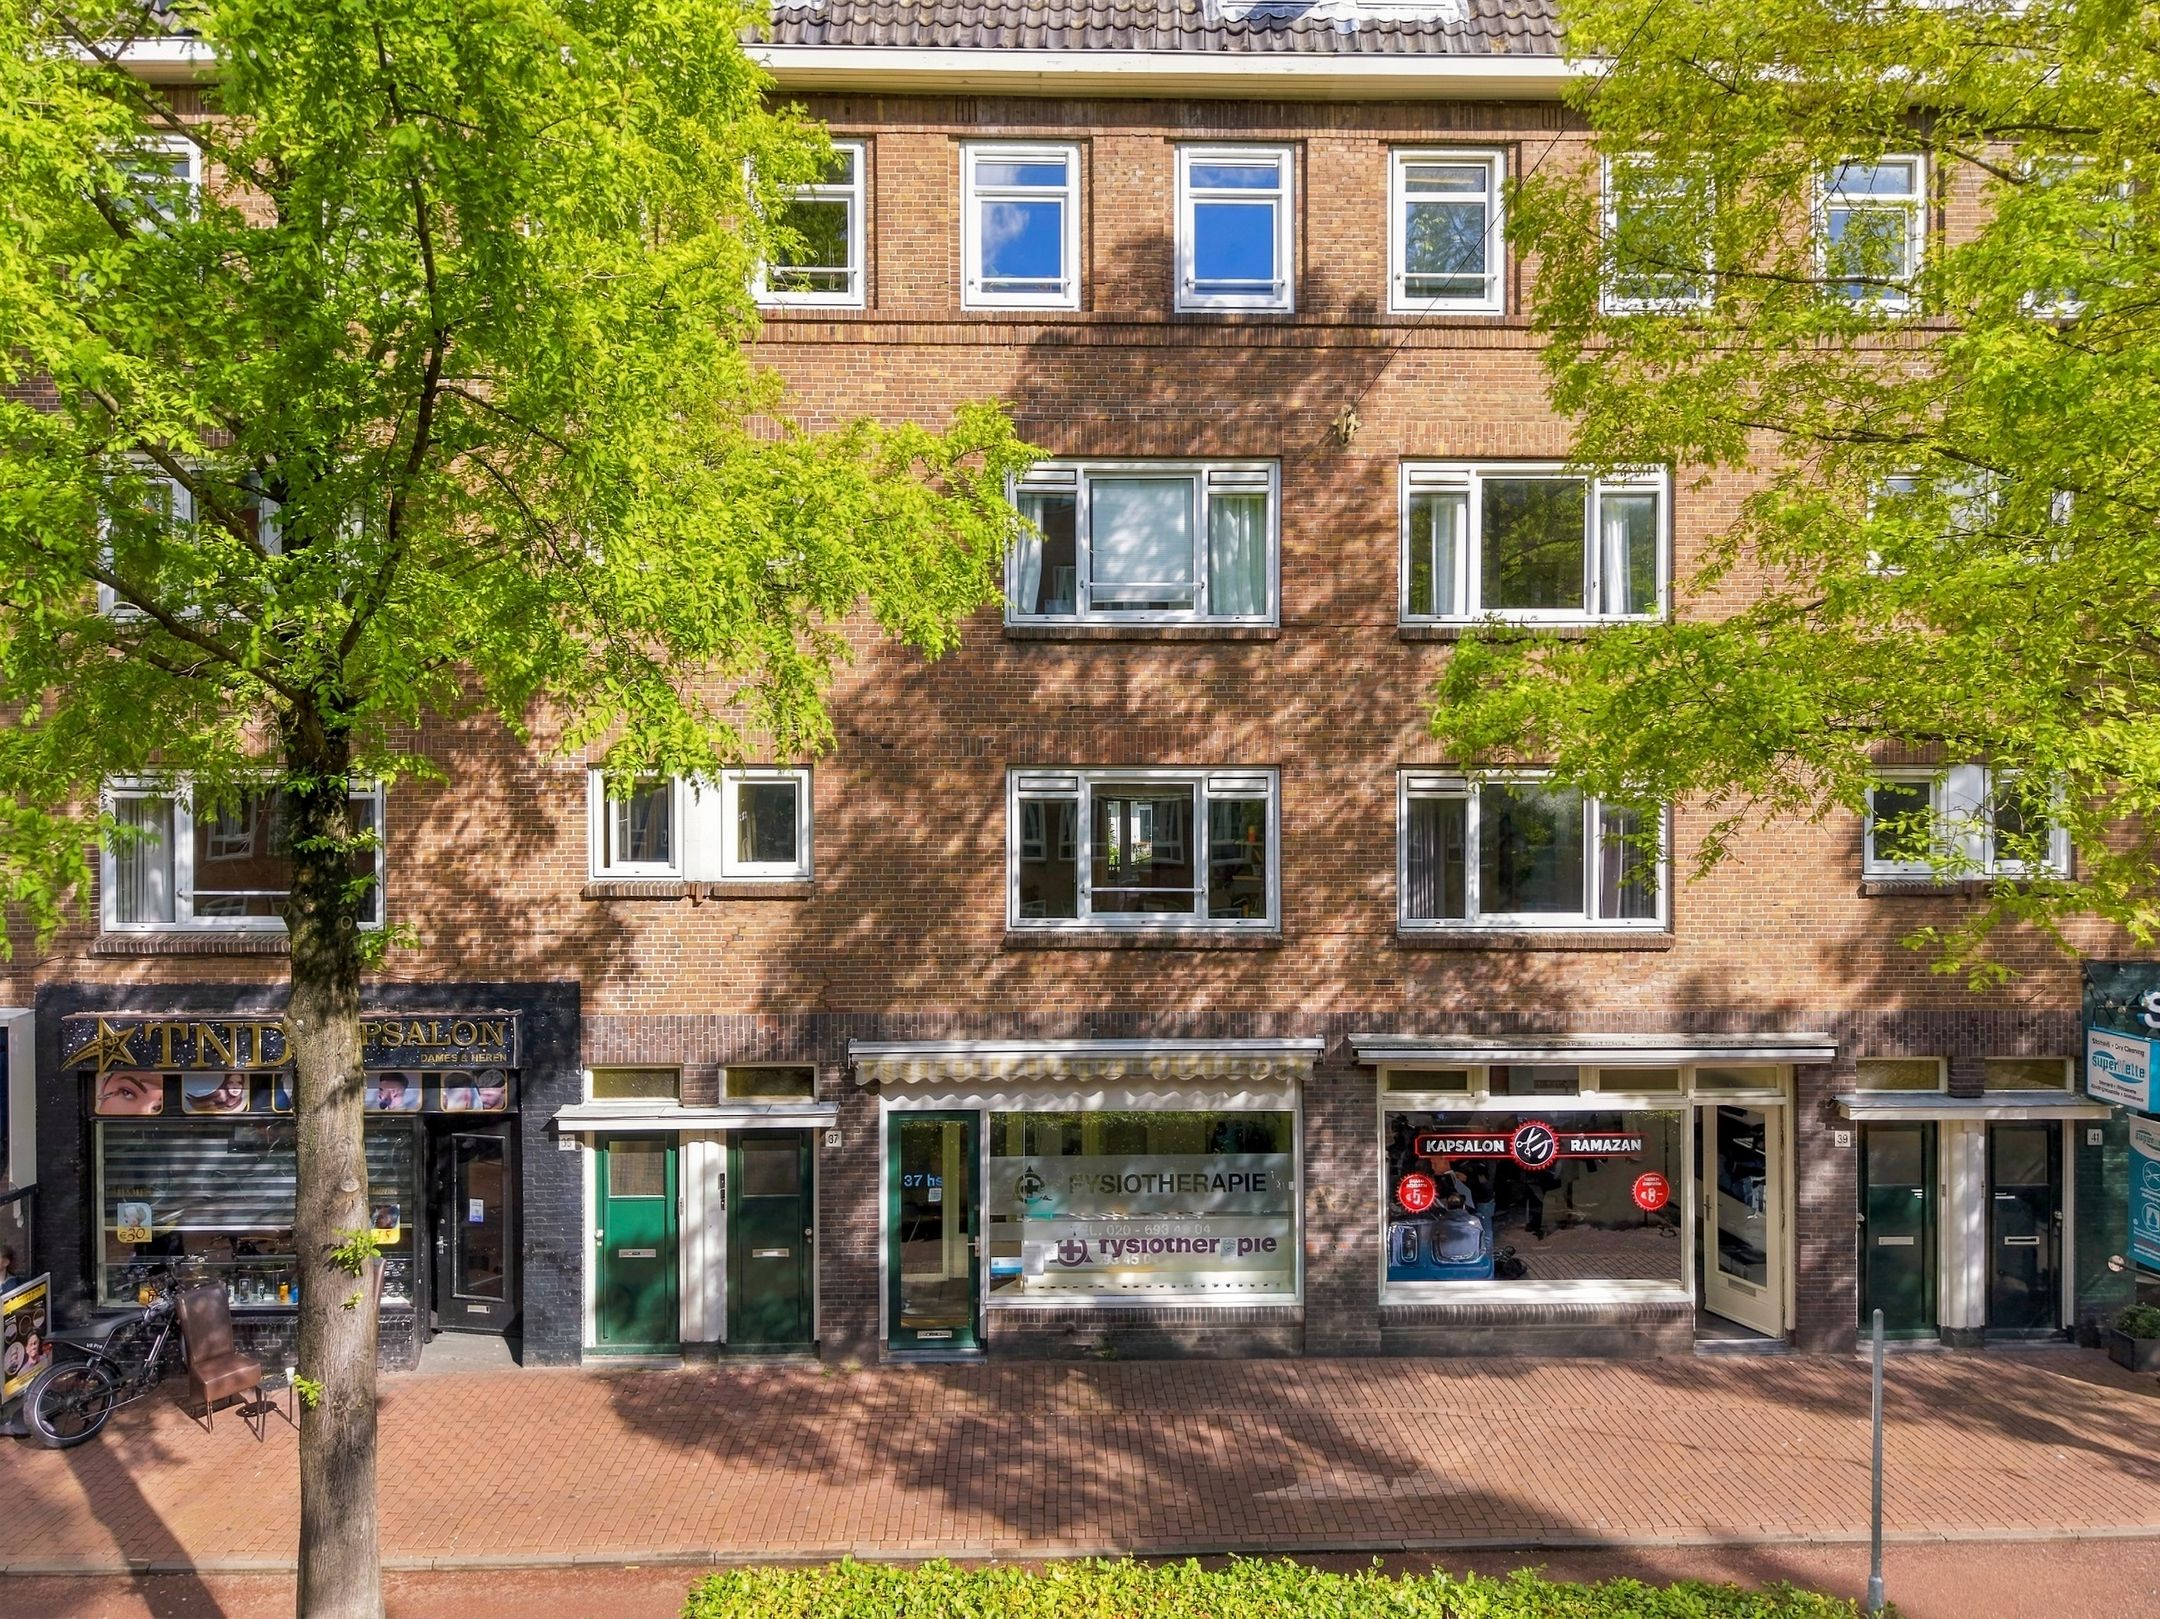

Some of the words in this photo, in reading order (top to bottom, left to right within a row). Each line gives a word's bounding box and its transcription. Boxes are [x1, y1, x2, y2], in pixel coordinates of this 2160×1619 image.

[145, 1023, 294, 1068] TND
[420, 1053, 458, 1063] DAMES
[461, 1054, 468, 1062] &
[471, 1053, 507, 1063] HEREN
[828, 1134, 839, 1144] 37
[1837, 1134, 1848, 1144] 39
[1426, 1140, 1505, 1153] KAPSALON
[1570, 1139, 1642, 1152] RAMAZAN
[903, 1174, 923, 1187] 37
[1069, 1173, 1267, 1194] FYSIOTHERAPIE
[1106, 1224, 1131, 1236] 020
[1144, 1224, 1169, 1235] 693
[1098, 1237, 1277, 1258] fysiotherpie
